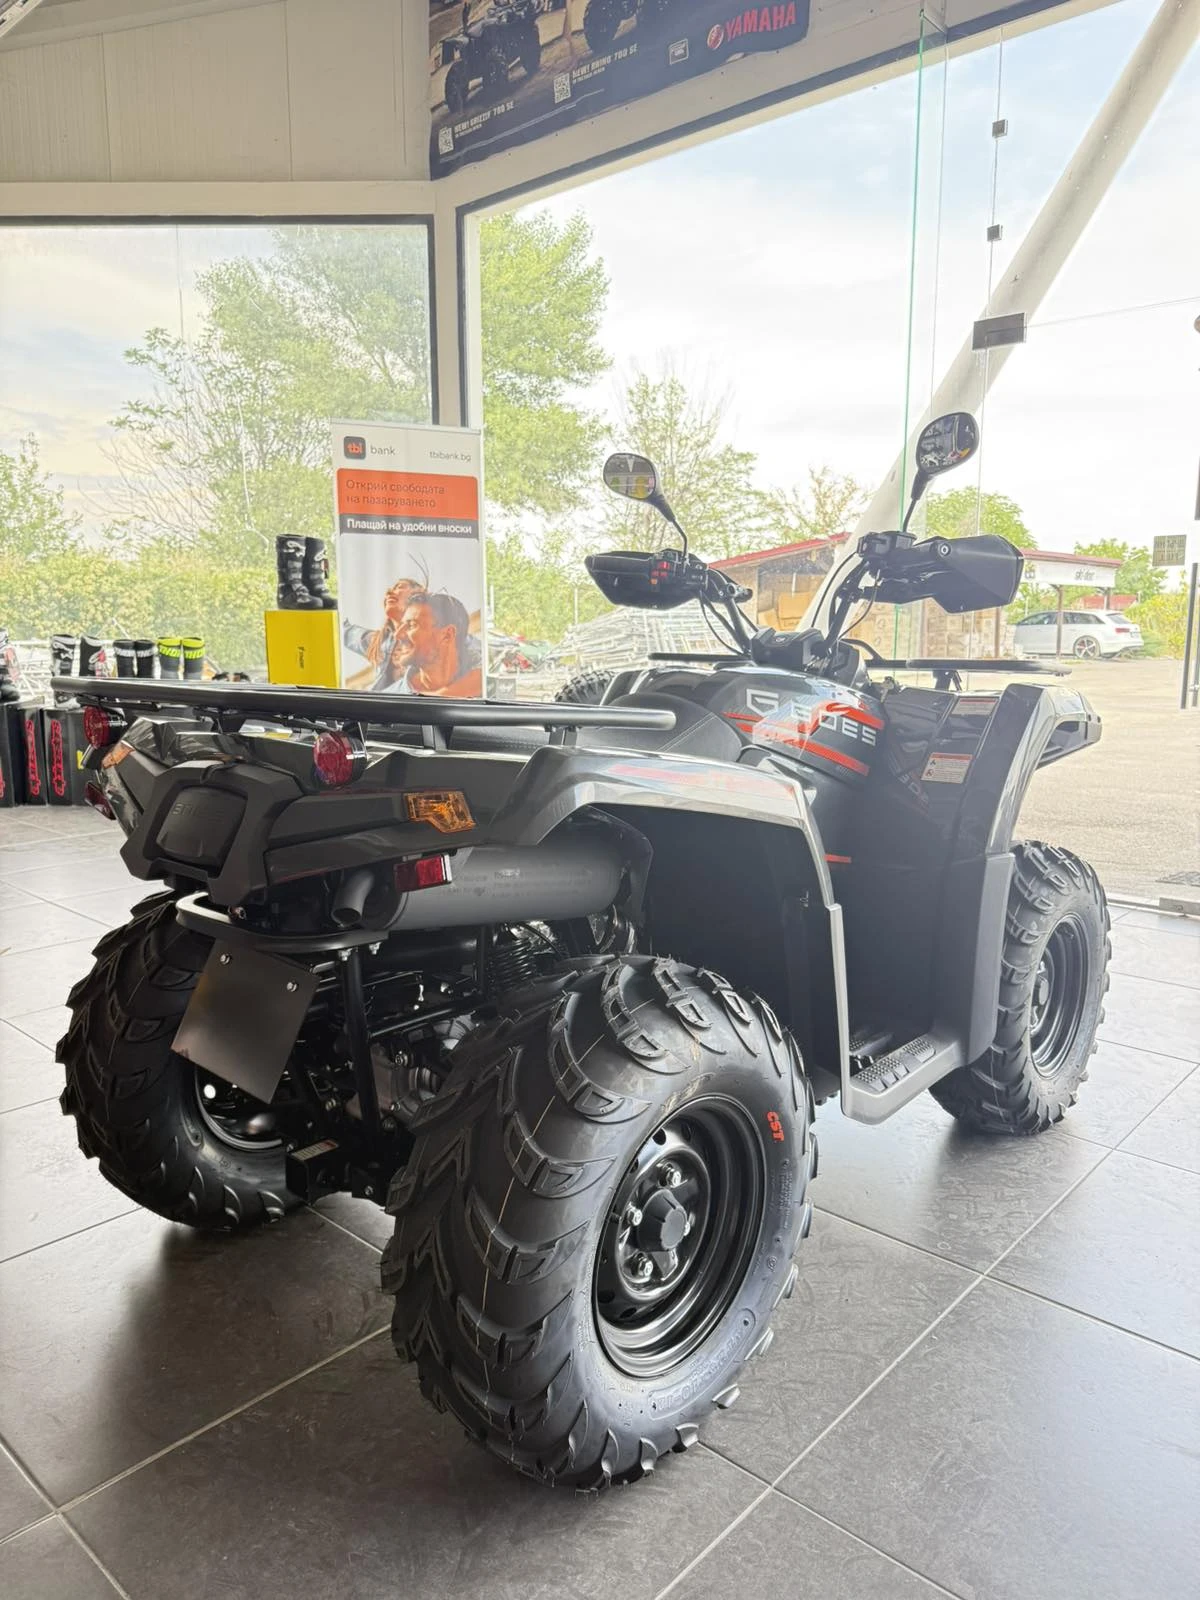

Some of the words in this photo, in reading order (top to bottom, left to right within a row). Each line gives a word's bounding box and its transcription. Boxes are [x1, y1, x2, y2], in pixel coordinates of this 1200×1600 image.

[725, 1, 797, 42] YAMAHA
[370, 445, 396, 456] bank
[429, 450, 472, 462] tbibank.bg
[346, 479, 387, 493] Открий
[389, 482, 445, 497] свободата
[346, 495, 360, 504] на
[362, 496, 436, 509] пазаруването
[346, 518, 387, 531] Плащай
[388, 521, 401, 530] на
[402, 521, 437, 534] удобни
[438, 525, 472, 534] вноски
[767, 1111, 785, 1142] CST
